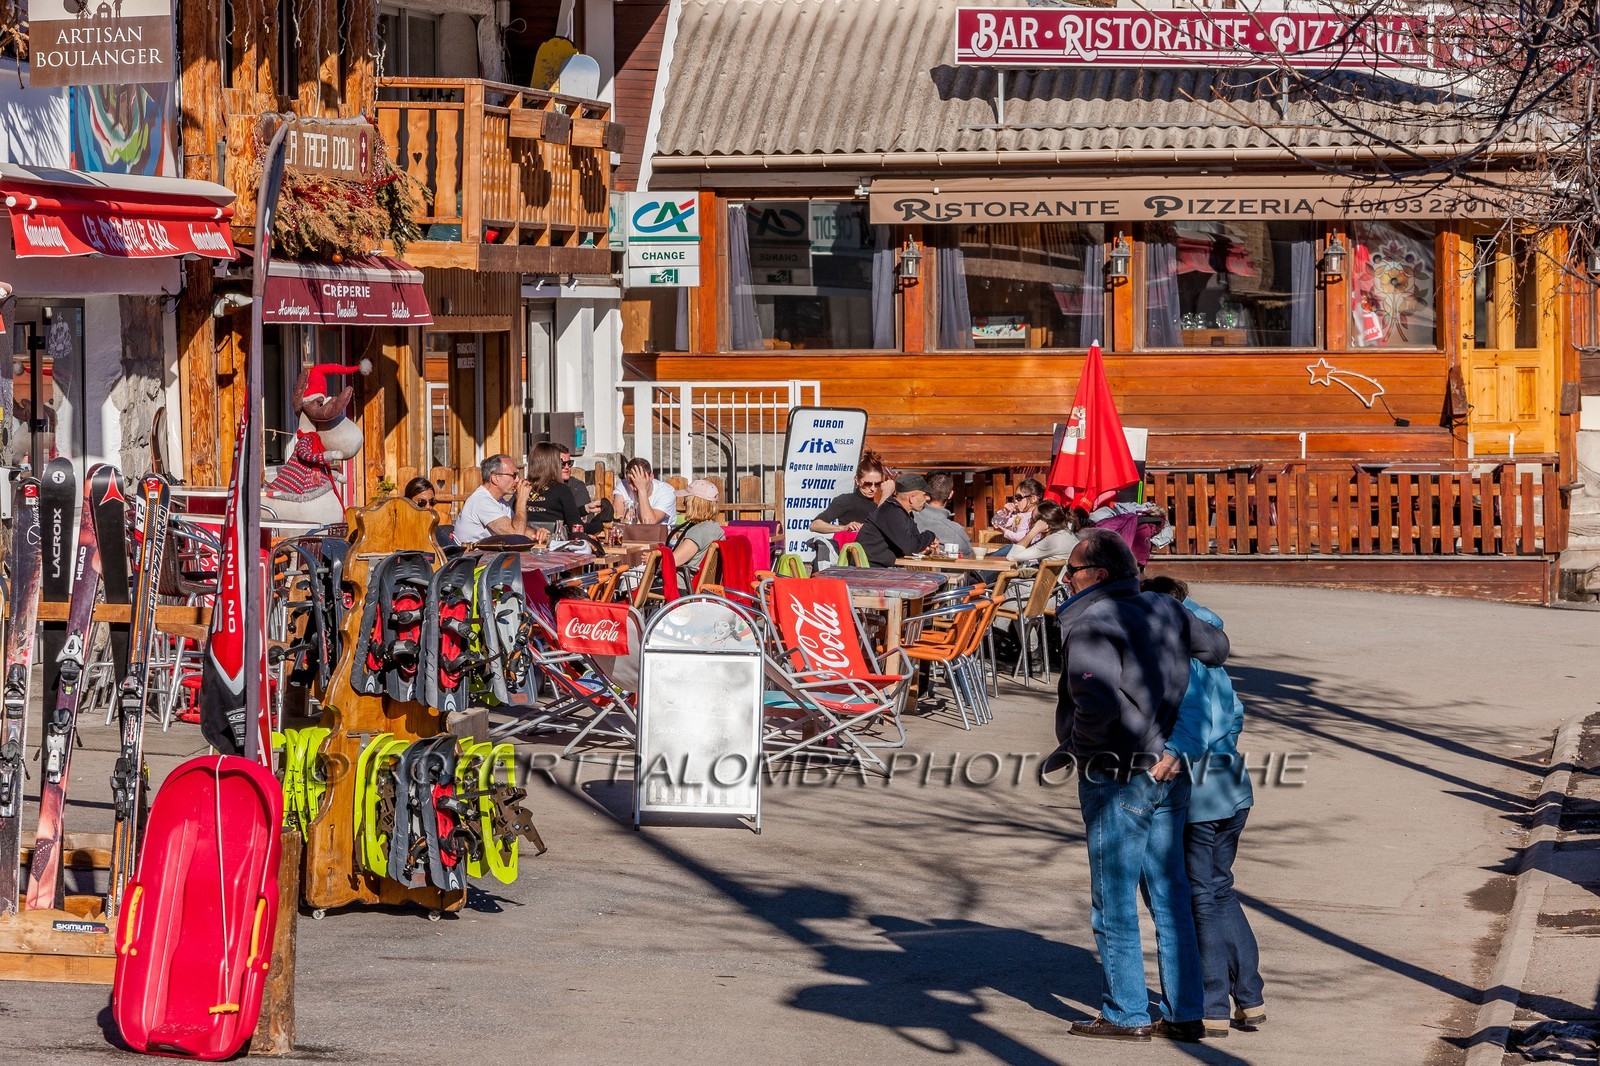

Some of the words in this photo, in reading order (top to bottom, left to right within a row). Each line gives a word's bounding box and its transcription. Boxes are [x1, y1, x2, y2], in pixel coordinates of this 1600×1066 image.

[56, 26, 143, 45] ARTISAN
[970, 12, 1038, 59] BAR
[1058, 13, 1251, 62] RISTORANTE
[1268, 16, 1414, 59] PIZZERIA
[35, 48, 163, 68] BOULANGER
[895, 198, 1120, 222] RISTORANTE
[1144, 196, 1315, 218] PIZZERIA
[1394, 199, 1423, 214] 93
[147, 219, 180, 252] BAR
[641, 251, 685, 260] CHANGE
[323, 283, 371, 298] CRÊPERIE
[813, 419, 844, 429] AURON
[789, 461, 813, 472] Agence
[815, 462, 854, 472] Immobilière
[801, 478, 836, 490] SYNDIC
[52, 508, 62, 578] LACROIX
[76, 545, 87, 580] HEAD
[565, 617, 620, 642] Coca-Cola
